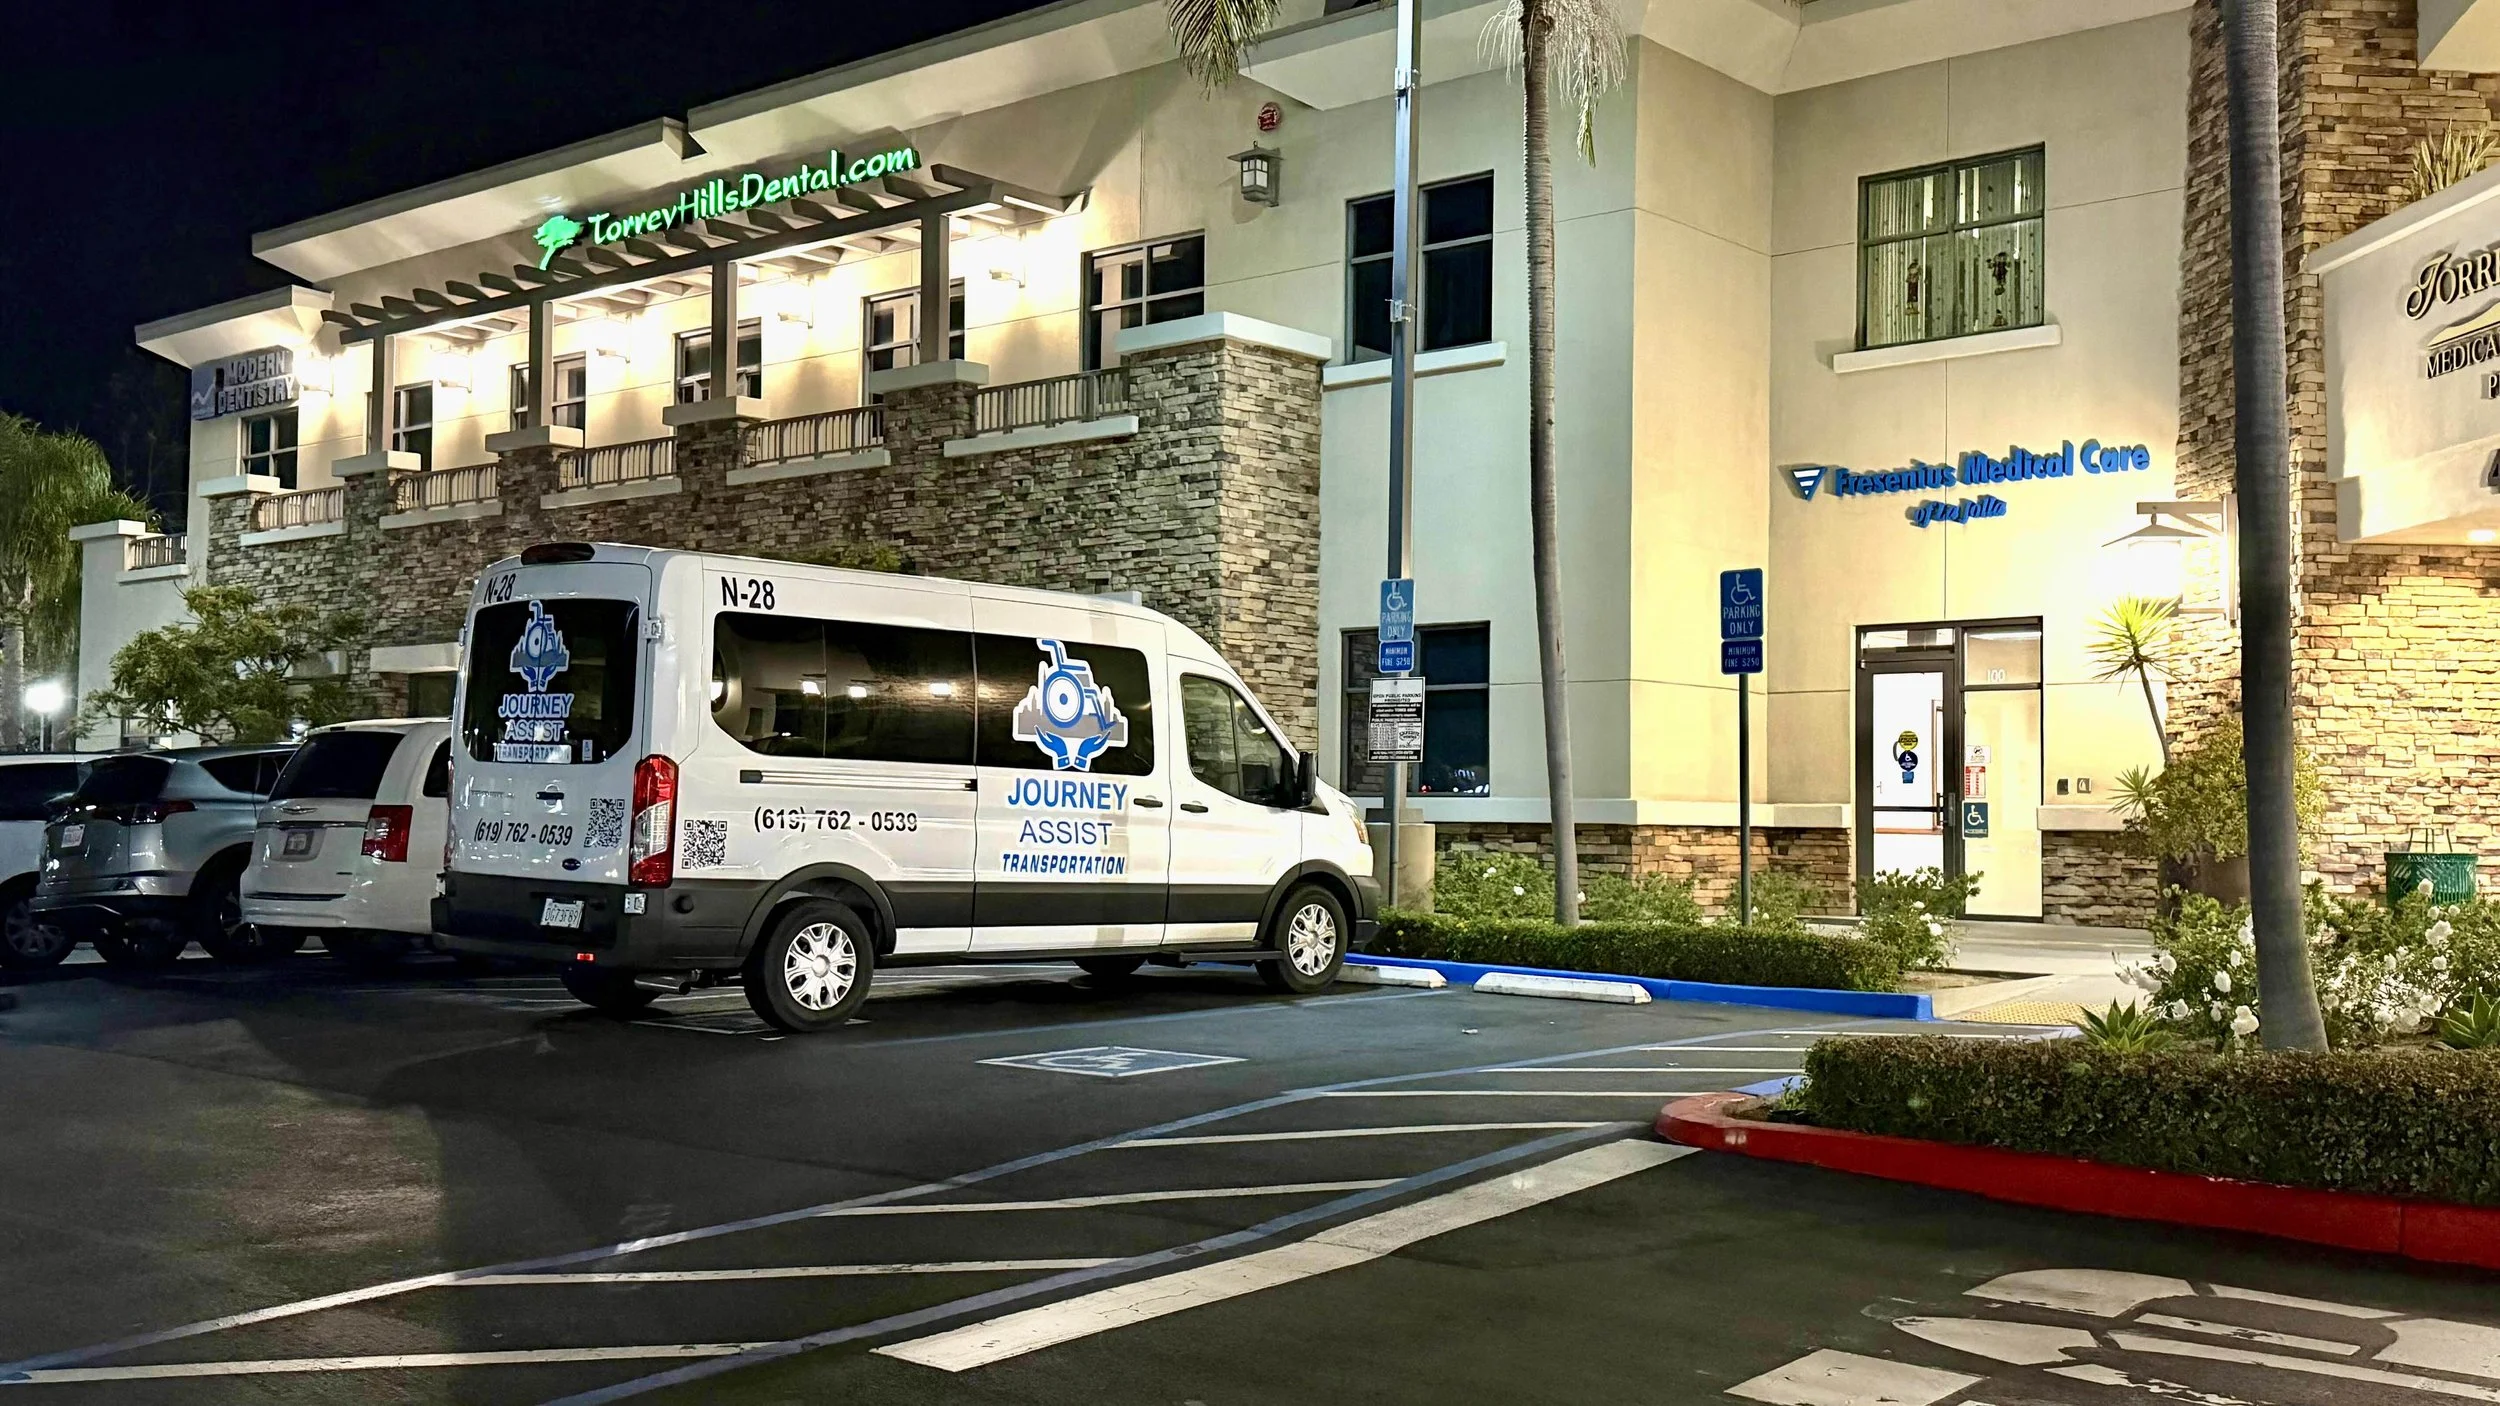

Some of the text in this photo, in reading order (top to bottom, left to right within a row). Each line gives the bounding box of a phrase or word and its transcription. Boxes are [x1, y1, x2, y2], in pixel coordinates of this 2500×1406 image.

[587, 147, 916, 245] TorreyHillsDental.com
[226, 350, 287, 385] MODERN
[2426, 331, 2500, 379] MEDICA
[217, 376, 295, 414] DENTISTRY
[1835, 438, 2150, 497] Fresenius Medical Care
[1914, 495, 2007, 528] of La Jolla
[483, 573, 516, 605] N-28
[721, 576, 775, 610] N-28
[1381, 610, 1412, 623] PARKING
[1723, 604, 1760, 619] PARKING
[1387, 625, 1406, 638] ONLY
[1729, 621, 1754, 635] ONLY
[1725, 657, 1760, 668] FINE $250
[1728, 646, 1756, 656] MINIMUM
[1987, 668, 2006, 683] 100
[499, 693, 574, 718] JOURNEY
[504, 719, 565, 742] ASSST
[1008, 777, 1128, 810] JOURNEY
[474, 817, 503, 843] (619)
[505, 822, 529, 843] 762
[539, 824, 573, 846] 0539
[754, 806, 806, 833] (619)
[815, 810, 851, 830] 762
[871, 811, 918, 832] 0539
[1019, 819, 1112, 845] ASSIST
[1003, 854, 1125, 875] TRANSPORTATION
